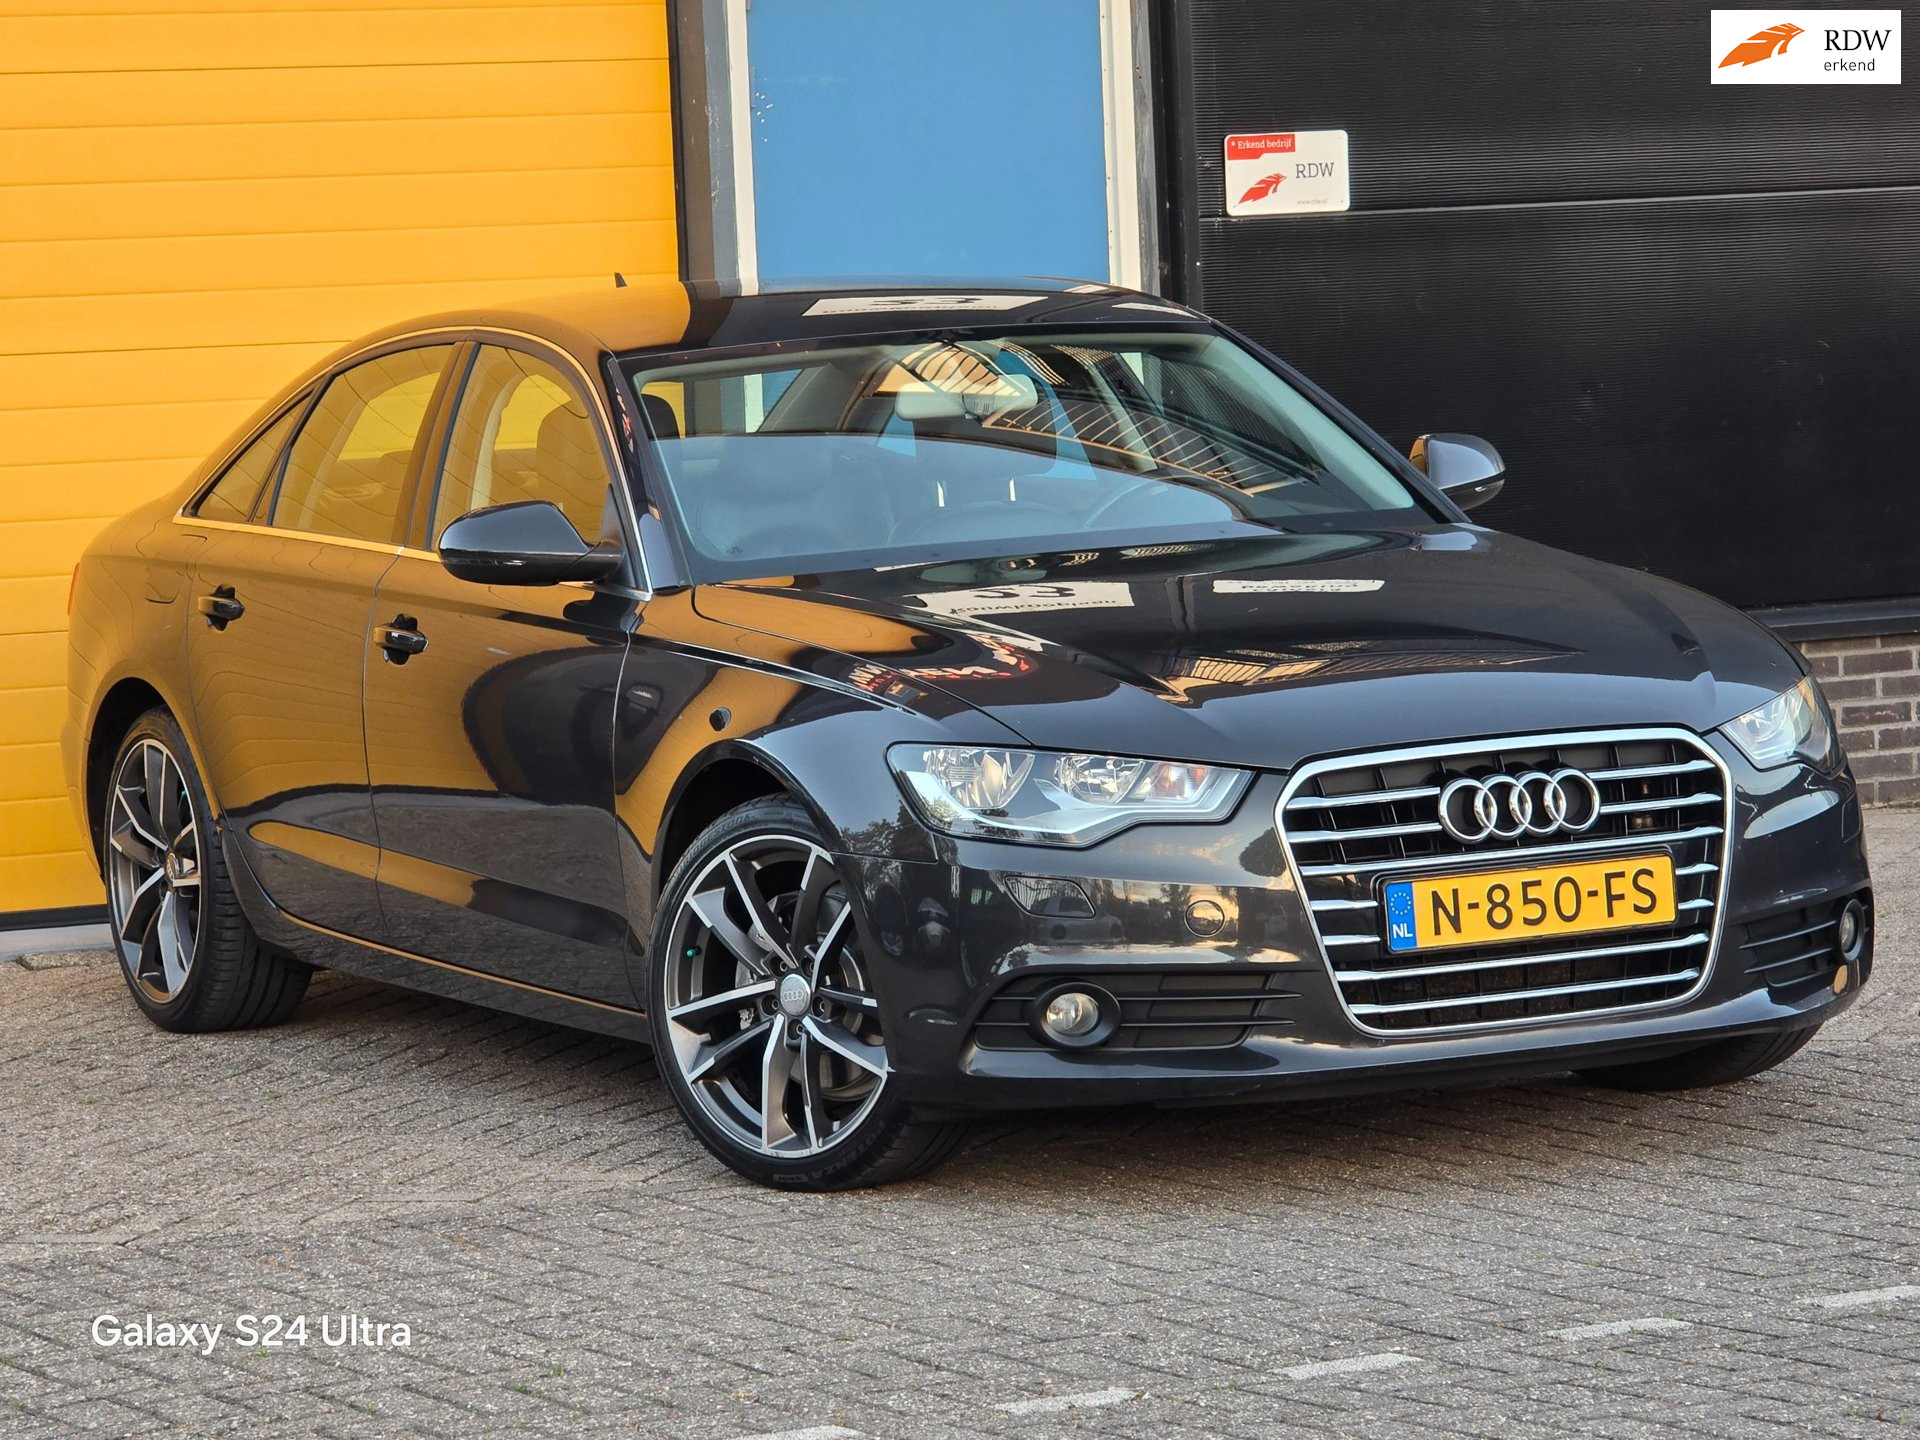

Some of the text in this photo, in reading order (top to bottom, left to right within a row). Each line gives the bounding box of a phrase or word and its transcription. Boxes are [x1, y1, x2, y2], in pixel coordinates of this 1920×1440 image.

[1237, 138, 1292, 150] Erkend bedrijf
[1295, 162, 1335, 178] RDW
[1431, 868, 1657, 936] N-850-FS
[1392, 923, 1413, 938] NL
